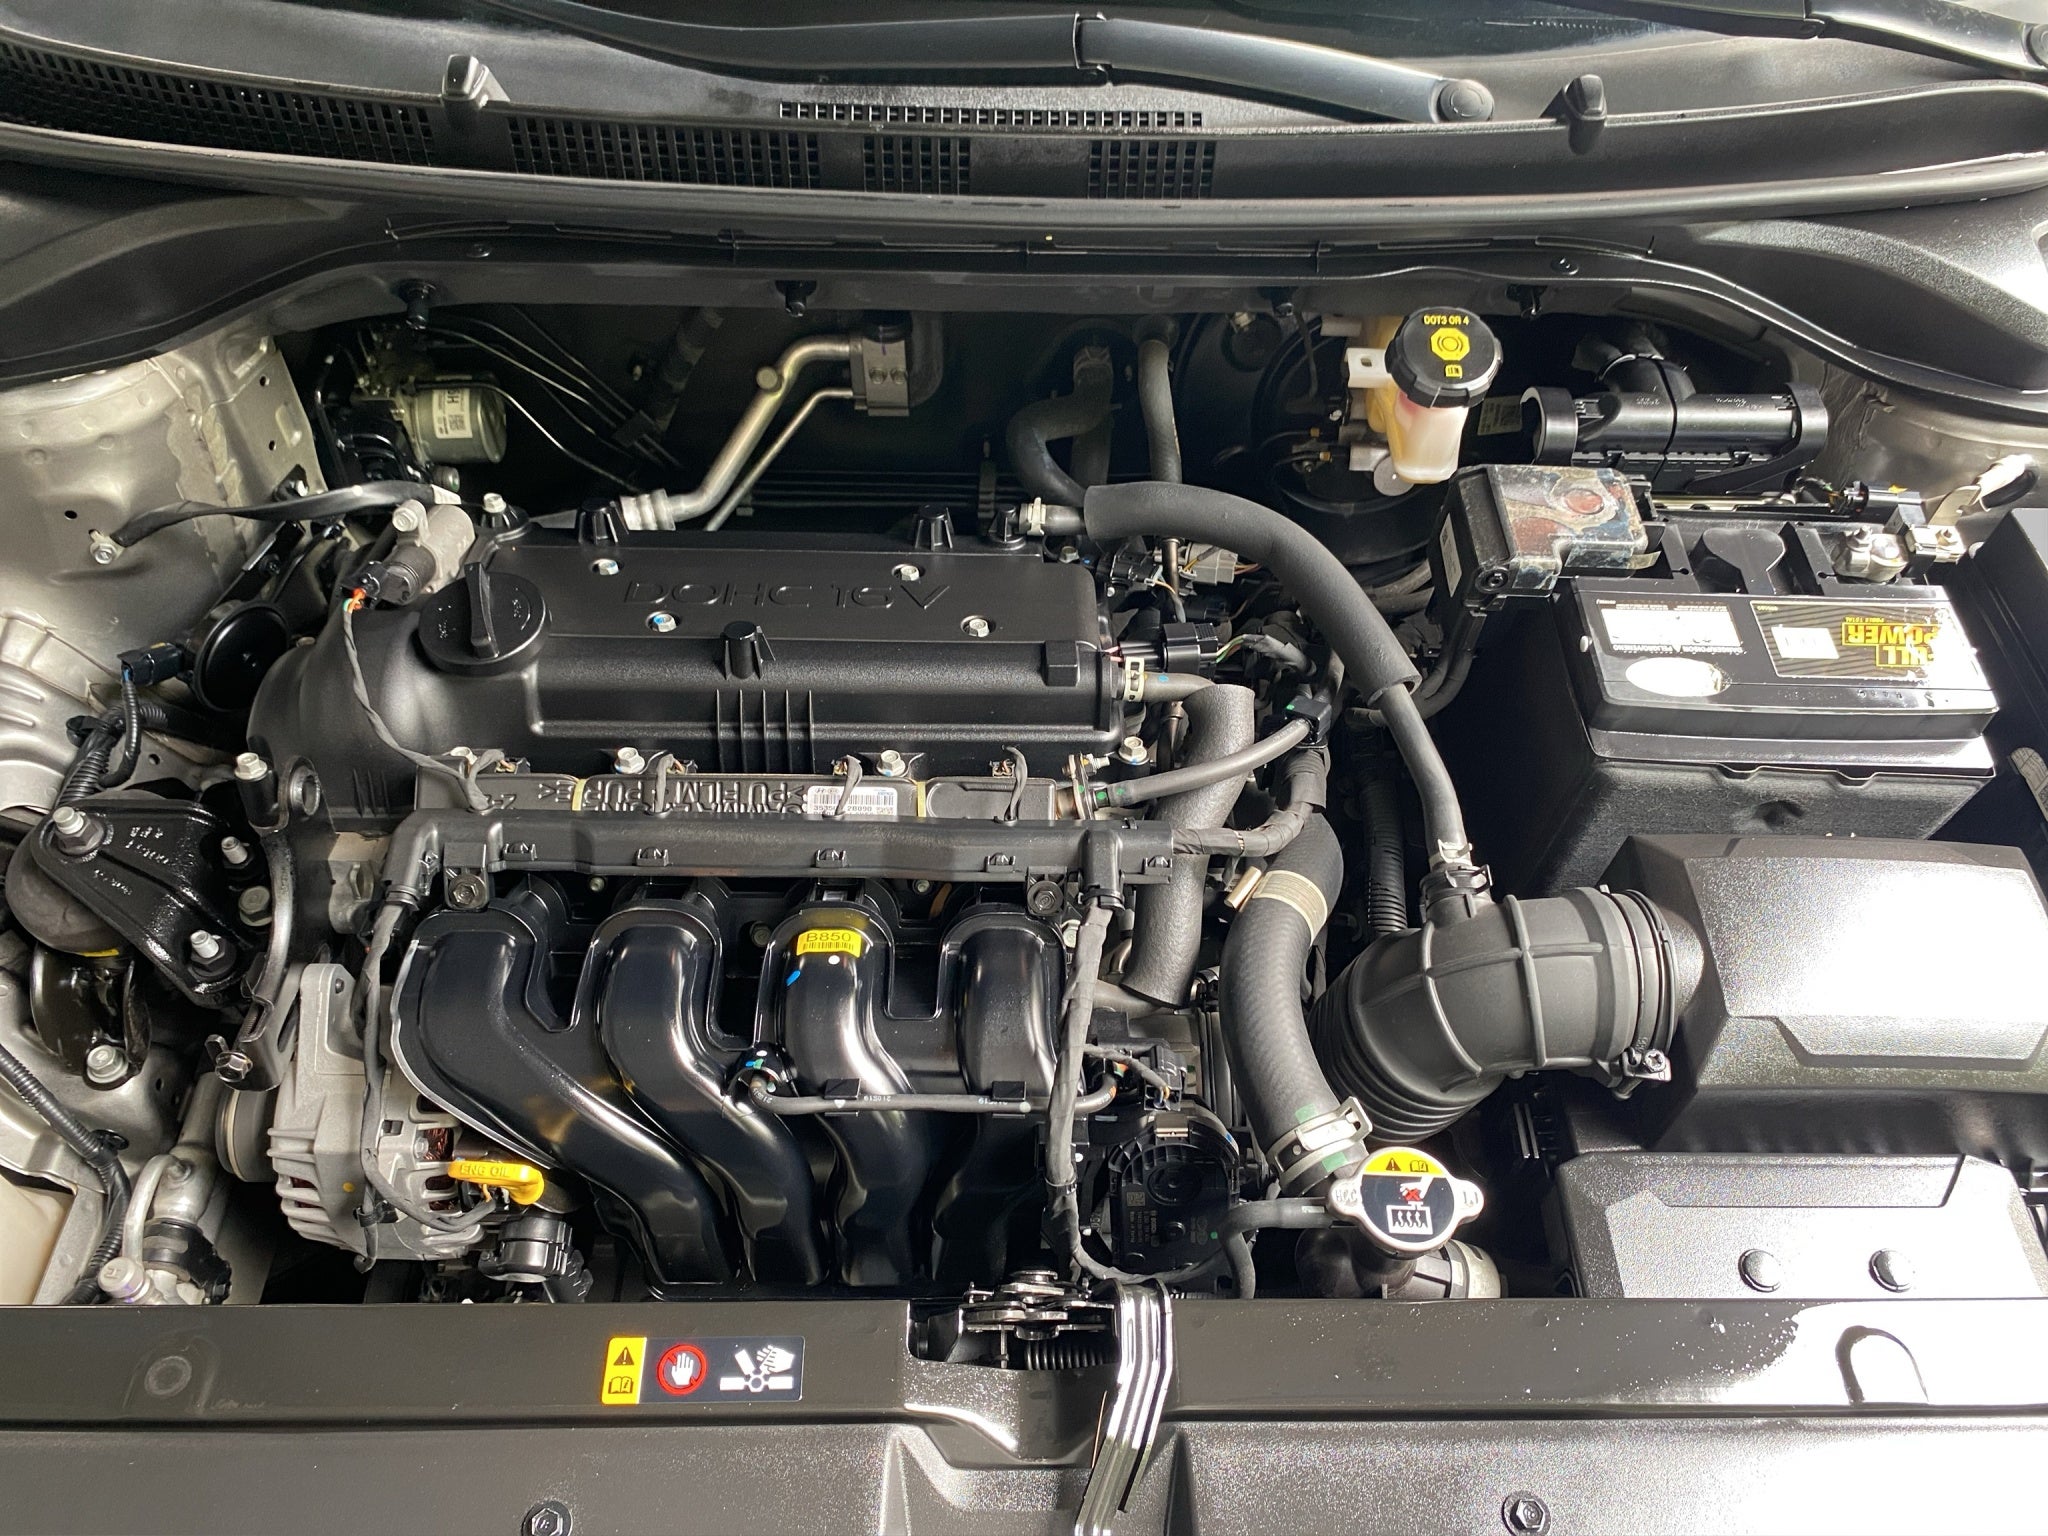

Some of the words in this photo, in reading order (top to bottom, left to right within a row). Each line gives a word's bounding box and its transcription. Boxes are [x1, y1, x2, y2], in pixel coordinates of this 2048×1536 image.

[1423, 314, 1447, 325] DOT3
[1448, 315, 1461, 325] OR
[1462, 315, 1470, 326] 4
[624, 581, 812, 608] DOHC
[830, 582, 950, 610] 16V
[806, 931, 852, 943] B850
[460, 1163, 485, 1176] ENG
[490, 1164, 510, 1177] OIL
